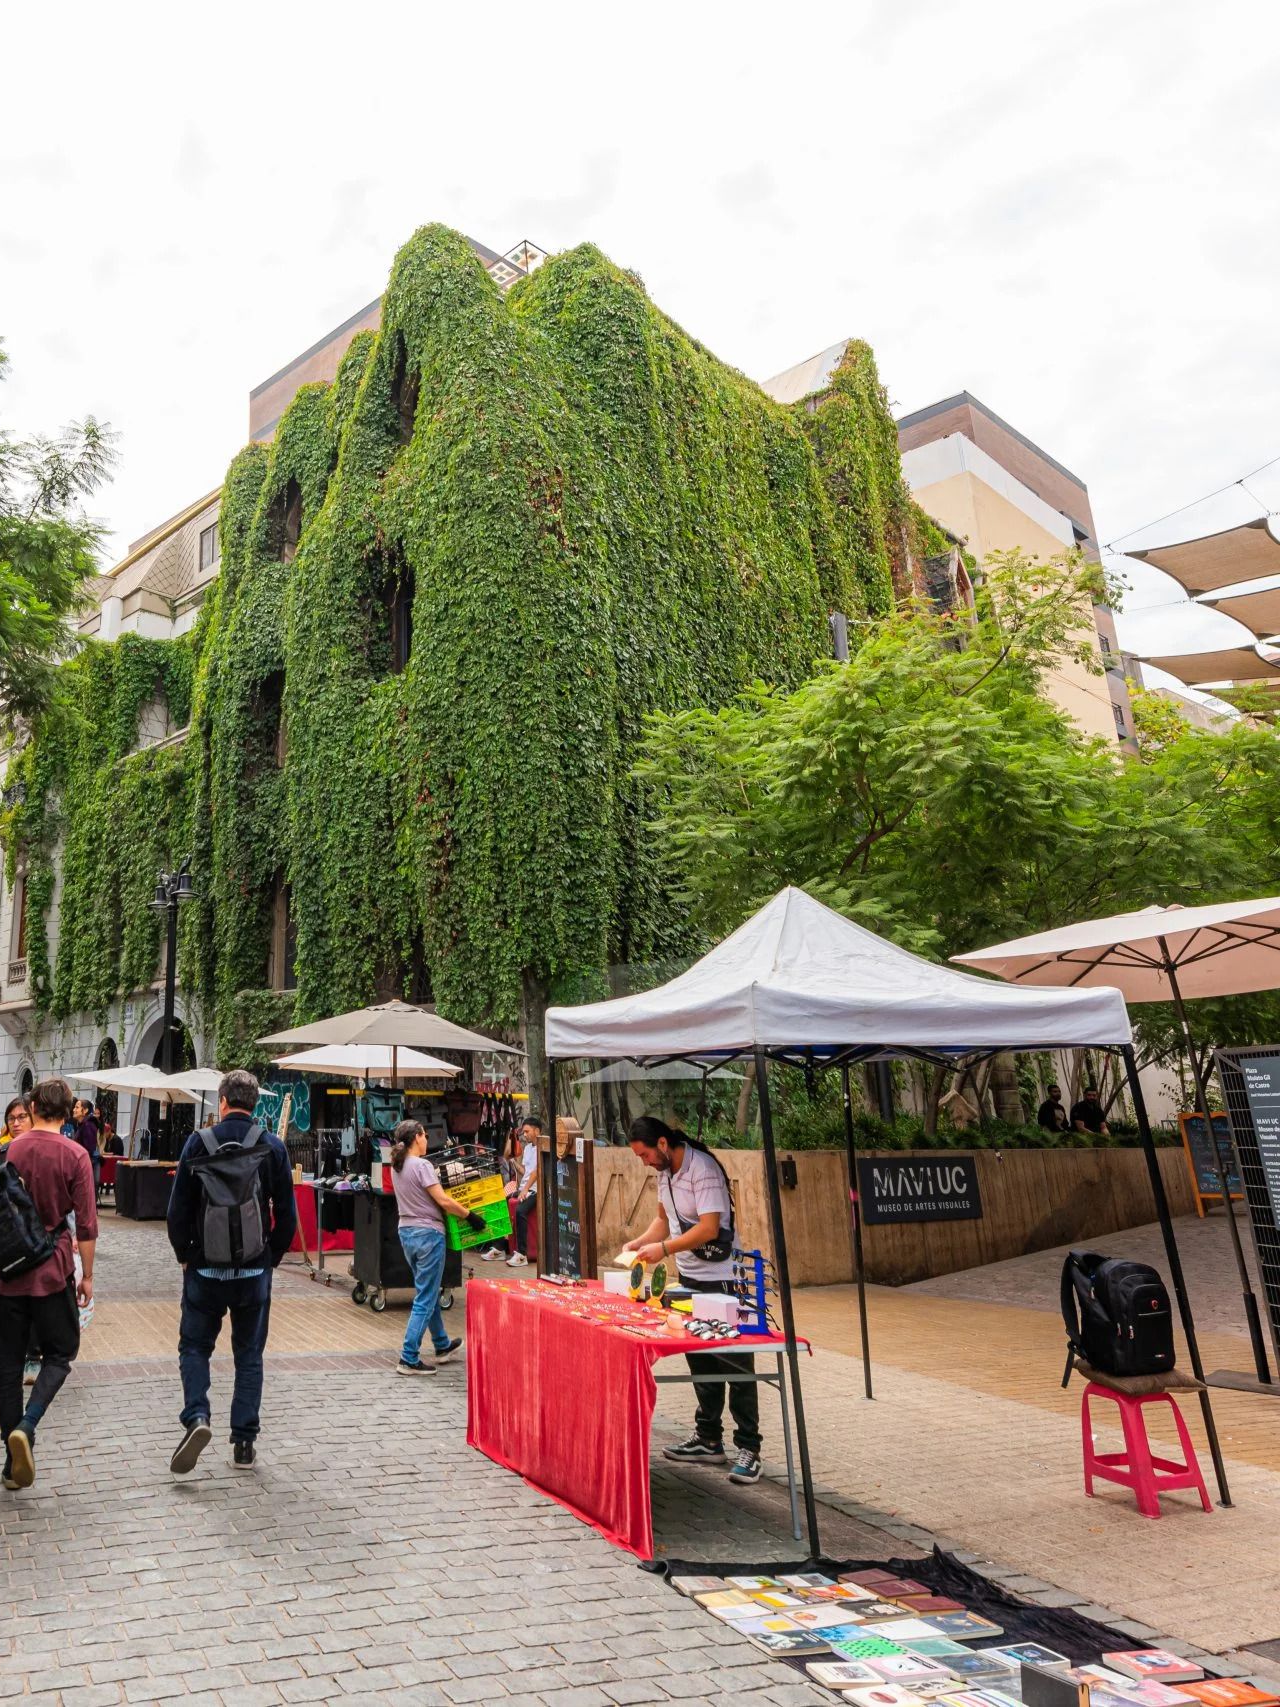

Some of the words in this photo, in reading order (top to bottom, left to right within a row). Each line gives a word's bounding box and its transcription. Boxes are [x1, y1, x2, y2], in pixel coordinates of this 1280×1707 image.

[873, 1167, 934, 1197] MAVI
[936, 1166, 967, 1195] UC
[877, 1203, 902, 1212] MUSEO
[904, 1203, 913, 1211] DE
[915, 1202, 936, 1210] ARTES
[938, 1201, 970, 1209] VISUALES
